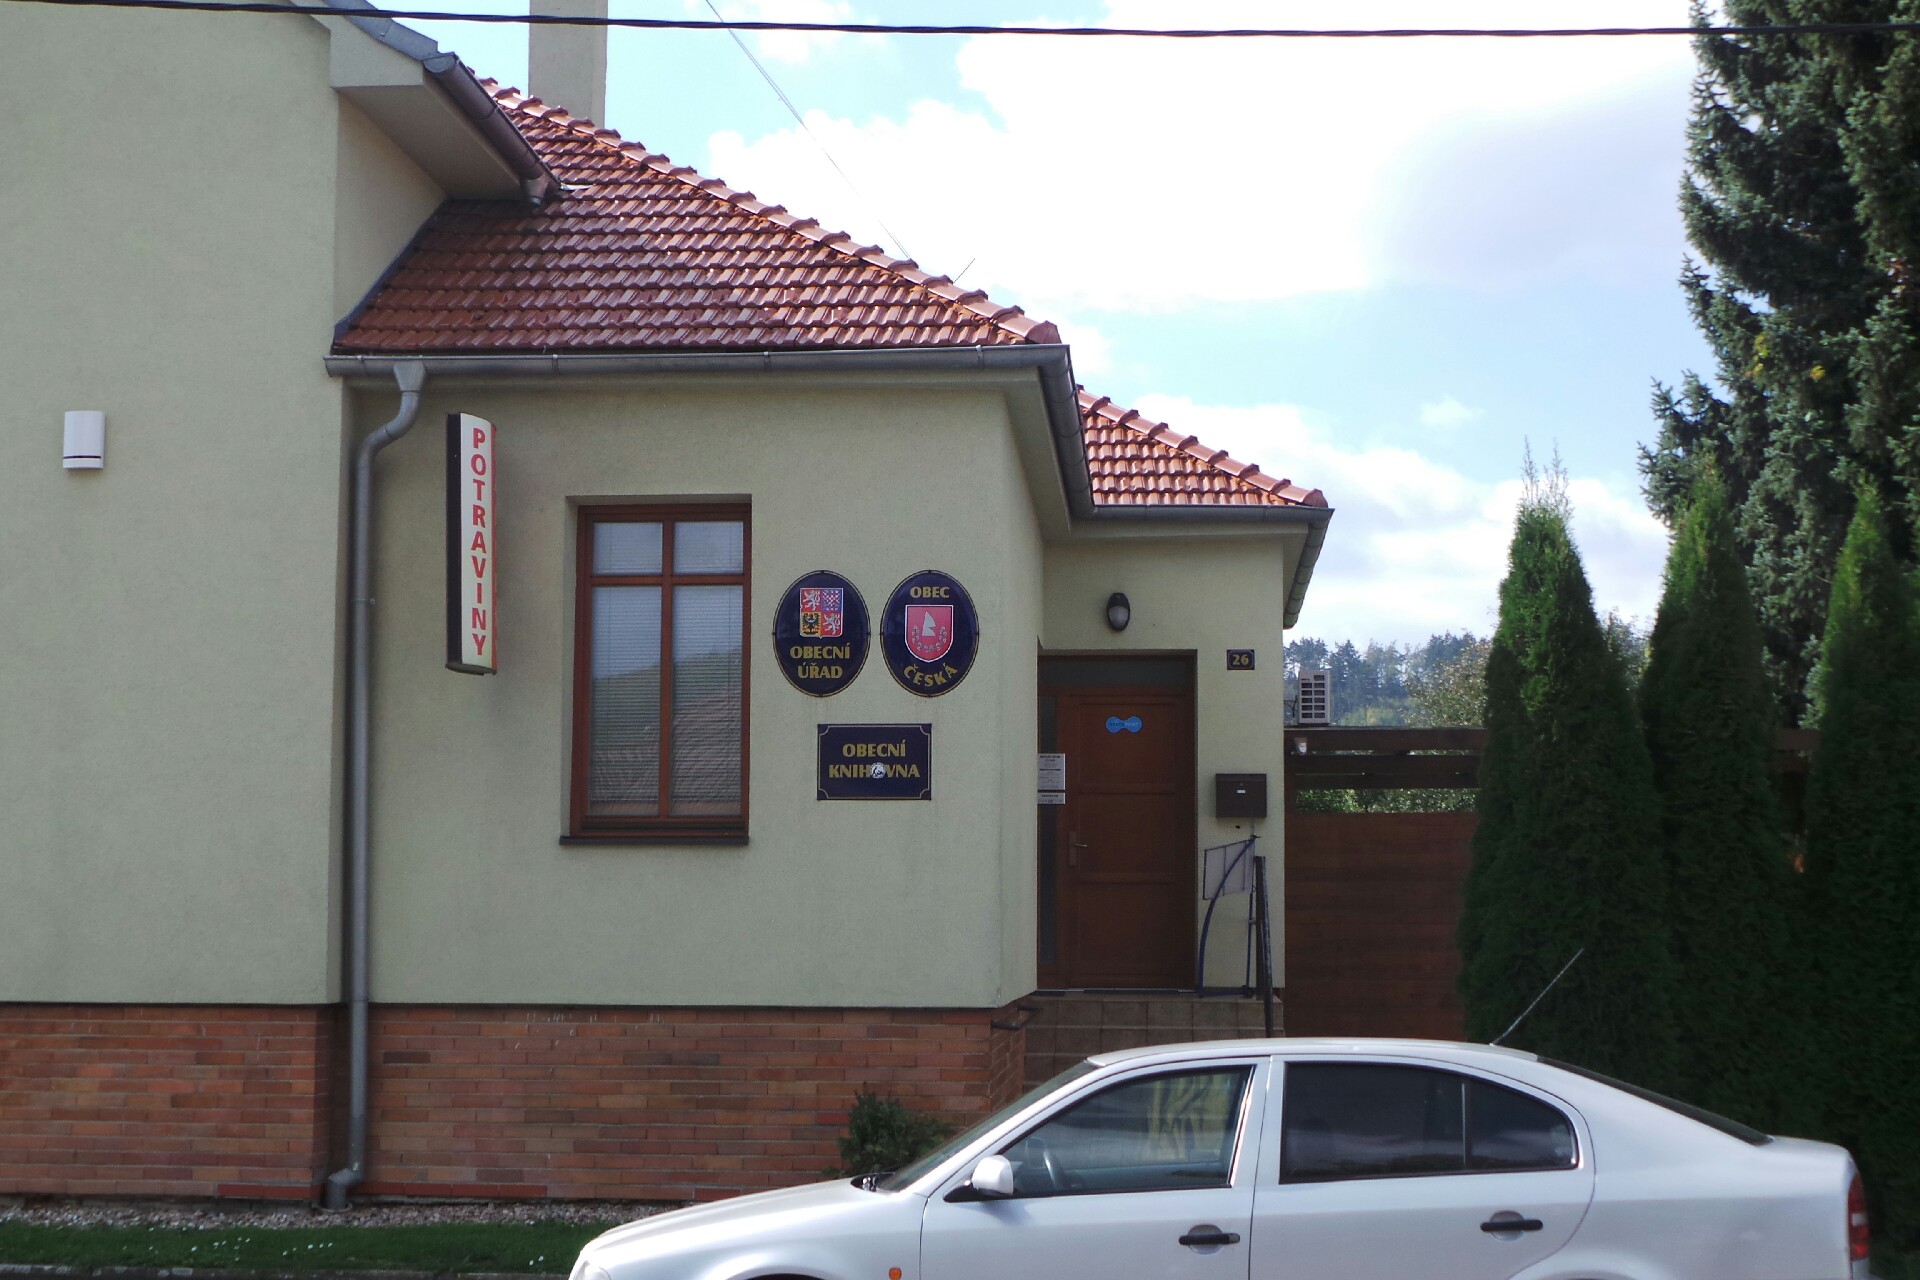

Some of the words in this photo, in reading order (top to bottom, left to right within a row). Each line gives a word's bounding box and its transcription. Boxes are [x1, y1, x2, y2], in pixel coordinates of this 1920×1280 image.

[471, 427, 487, 656] POTRAVINY
[910, 586, 950, 599] OBEC
[789, 642, 851, 659] OBECNÍ
[1232, 654, 1249, 665] 26
[797, 661, 843, 679] ÚŘAD
[903, 662, 958, 687] ČESKÁ
[842, 739, 906, 758] OBECNÍ
